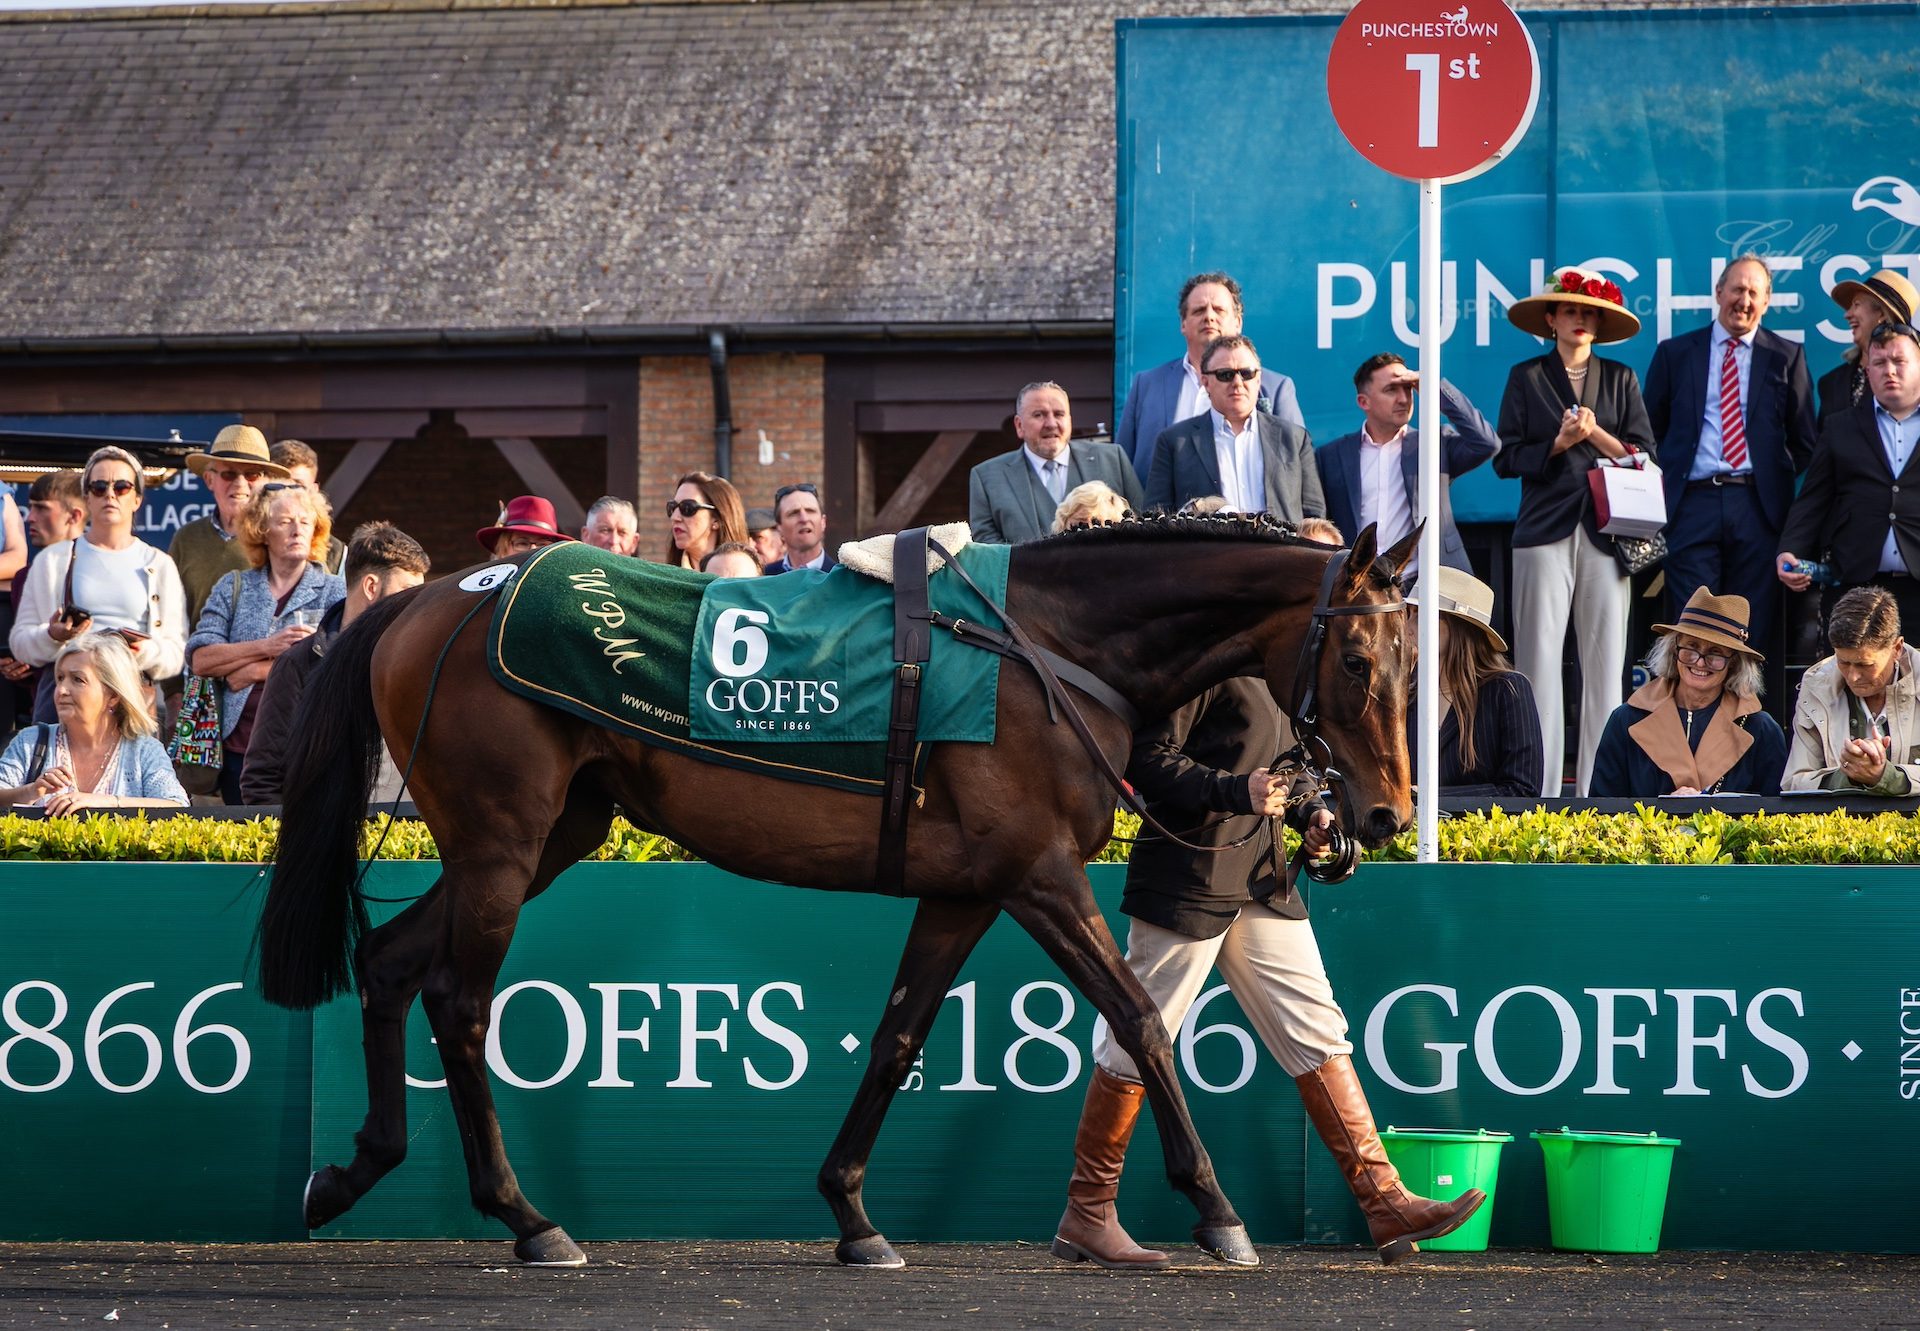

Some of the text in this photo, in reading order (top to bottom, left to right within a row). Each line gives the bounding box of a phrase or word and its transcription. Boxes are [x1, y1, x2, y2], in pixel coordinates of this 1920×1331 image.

[1361, 22, 1498, 38] PUNCHESTOWN
[1405, 52, 1481, 148] 1st
[478, 574, 496, 587] 6
[568, 568, 646, 675] WPM
[711, 607, 770, 678] 6
[705, 677, 840, 714] GOFFS
[735, 719, 811, 731] SINCE 1866
[404, 979, 809, 1091] OFFS
[939, 980, 1258, 1093] 186
[1363, 983, 1809, 1099] GOFFS
[1900, 987, 1920, 1100] SINCE
